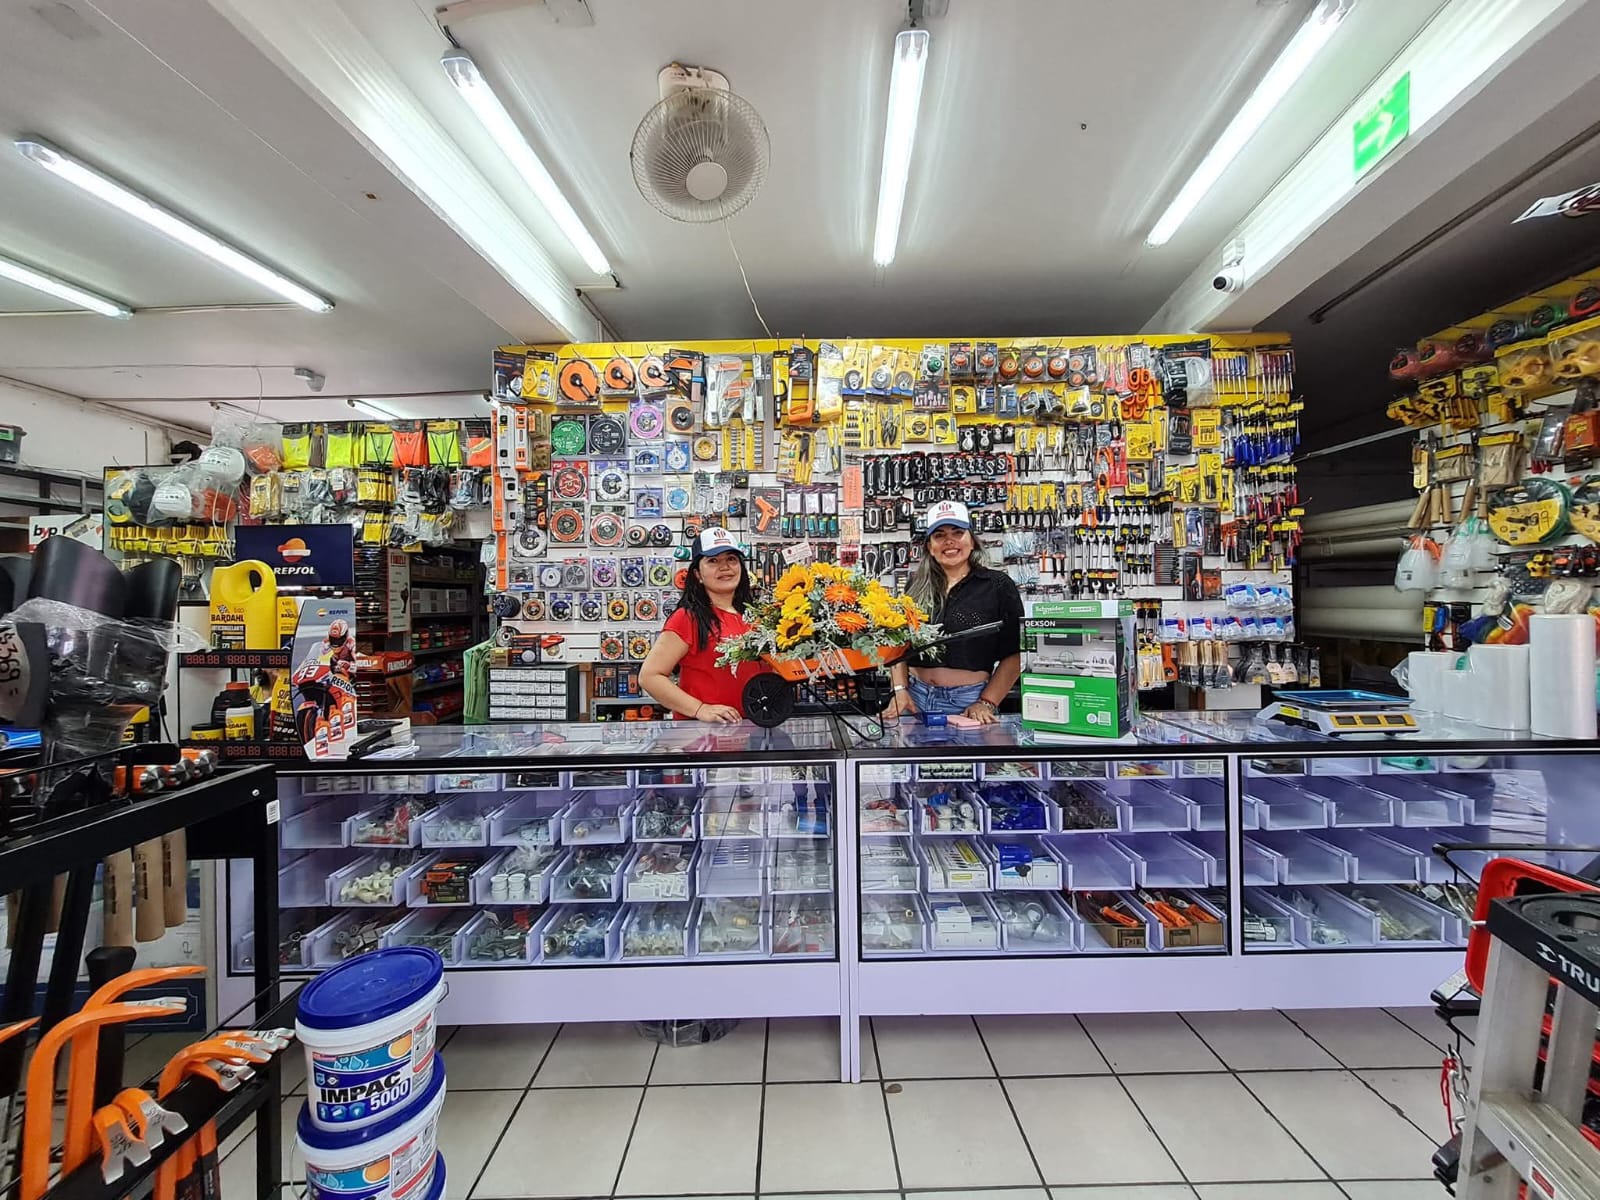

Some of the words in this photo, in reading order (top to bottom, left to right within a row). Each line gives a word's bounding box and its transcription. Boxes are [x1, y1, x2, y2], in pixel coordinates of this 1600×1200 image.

[33, 525, 57, 538] byp
[274, 566, 315, 575] REPSOL
[210, 614, 244, 622] BARDAHL
[331, 675, 354, 693] REPSOL
[321, 1071, 401, 1103] IMPAC
[370, 1080, 409, 1111] 5000
